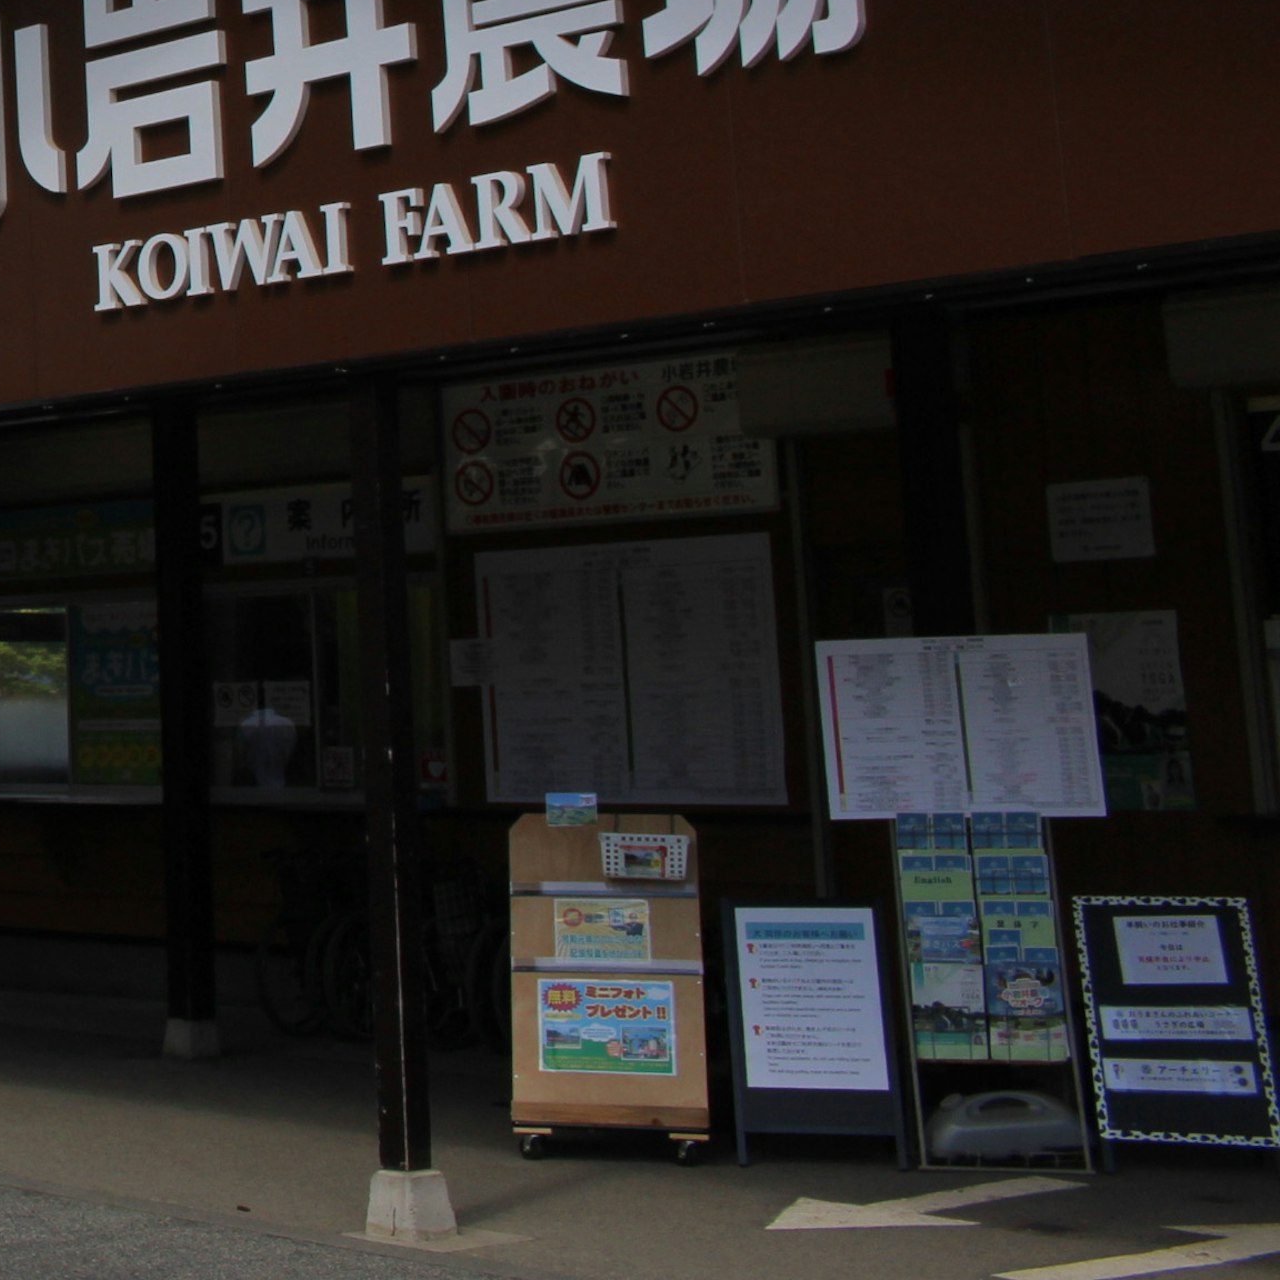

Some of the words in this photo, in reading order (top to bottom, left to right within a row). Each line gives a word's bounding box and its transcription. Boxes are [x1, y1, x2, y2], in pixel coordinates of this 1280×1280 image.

[92, 200, 355, 313] KOIWAI
[379, 150, 619, 268] FARM
[661, 360, 737, 383] 小岩井農
[480, 369, 640, 404] 入園時のおねがい
[199, 514, 219, 551] 5
[914, 875, 953, 885] English
[584, 984, 646, 1001] ミニフォト
[1156, 1064, 1222, 1075] アーチェリー
